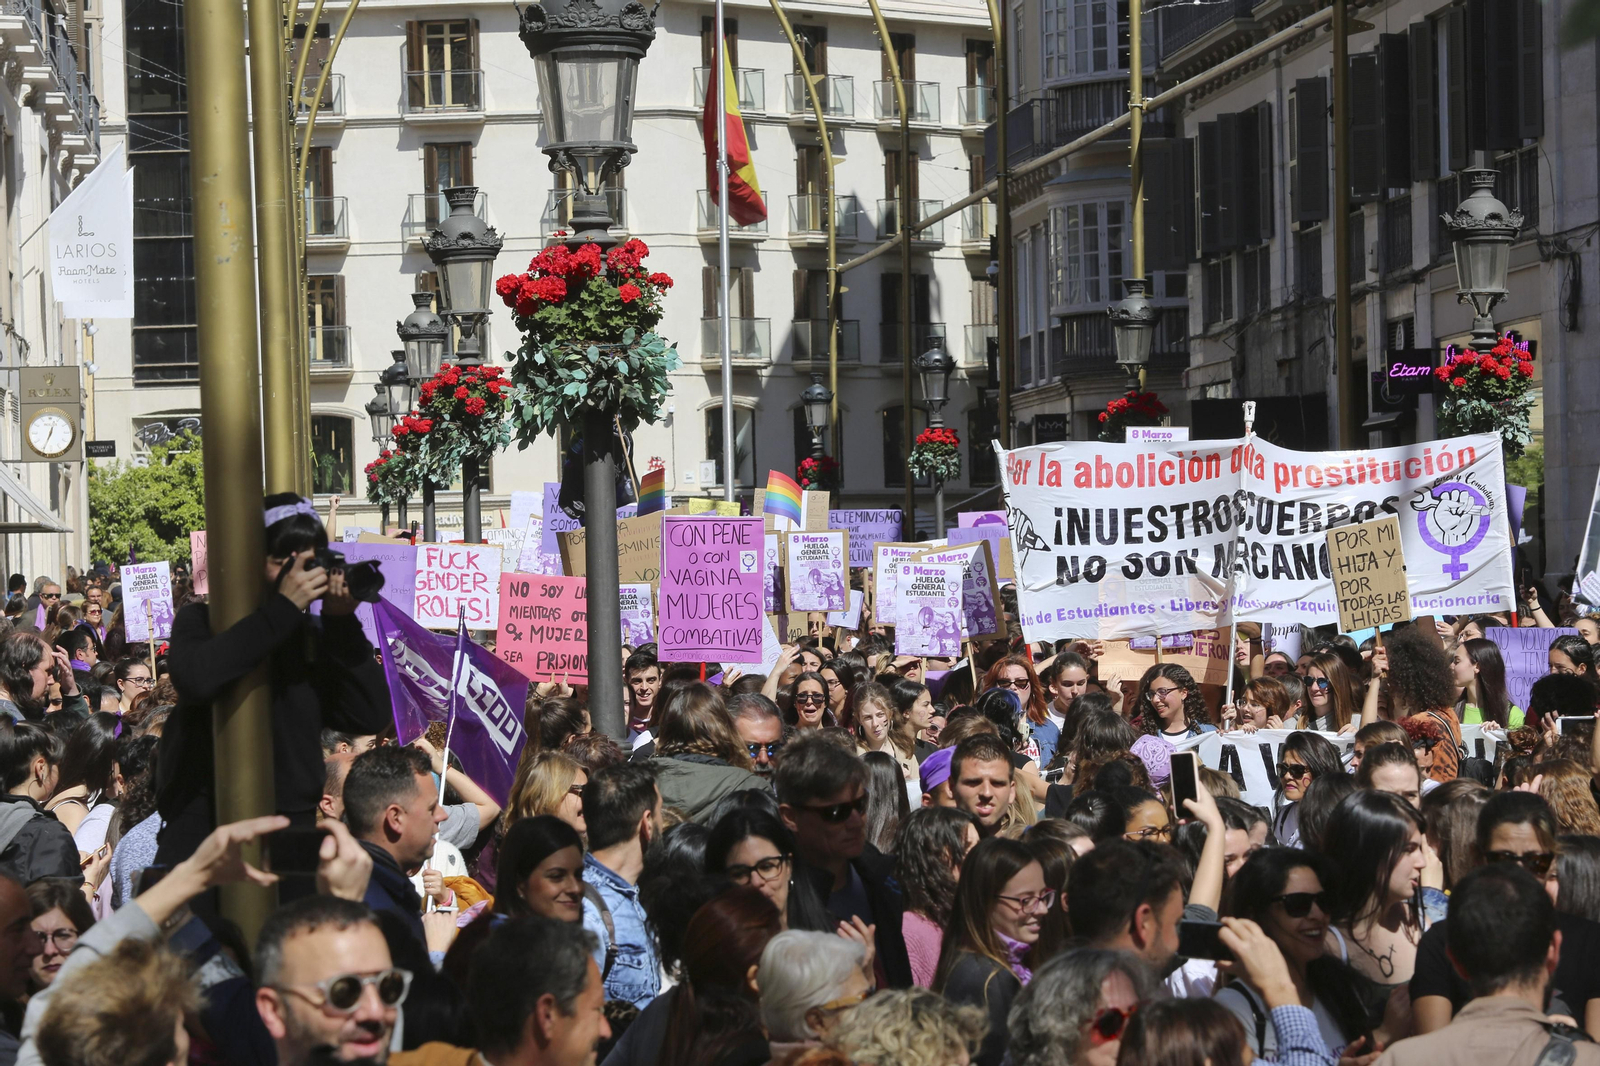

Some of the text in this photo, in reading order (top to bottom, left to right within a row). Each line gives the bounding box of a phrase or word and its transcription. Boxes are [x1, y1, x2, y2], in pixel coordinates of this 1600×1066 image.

[56, 243, 117, 259] LARIOS
[1389, 362, 1431, 377] Etam
[28, 388, 72, 398] ROLEX
[1037, 421, 1064, 430] NYX
[1132, 429, 1173, 439] 8 Marzo
[1038, 452, 1063, 488] la
[1073, 450, 1221, 489] abolición
[1273, 445, 1477, 494] prostitución
[830, 511, 902, 524] EL FEMINISMO
[670, 523, 752, 547] CON PENE
[792, 535, 829, 543] 8 Marzo
[1335, 523, 1395, 552] POR MI
[426, 547, 480, 571] FUCK
[703, 550, 730, 563] CON
[882, 548, 889, 557] 8
[937, 552, 968, 563] Marzo
[1337, 547, 1396, 575] HIJA Y
[125, 566, 157, 576] 8 Marzo
[902, 565, 946, 576] 8 Marzo
[1055, 554, 1107, 585] NO
[1120, 548, 1199, 580] SON
[415, 569, 491, 595] GENDER
[915, 576, 946, 584] HUELGA
[1340, 576, 1372, 597] POR
[509, 581, 530, 598] NO
[540, 584, 564, 599] SOY
[666, 592, 759, 620] MUJERES
[1340, 590, 1406, 612] TODAS LAS
[509, 605, 562, 622] MIENTRAS
[1036, 612, 1052, 624] de
[1056, 601, 1156, 621] Estudiantes
[1351, 605, 1402, 629] HIJAS
[530, 624, 587, 644] MUJER
[1492, 628, 1510, 651] NO
[503, 650, 523, 662] SEA
[1505, 652, 1515, 674] A
